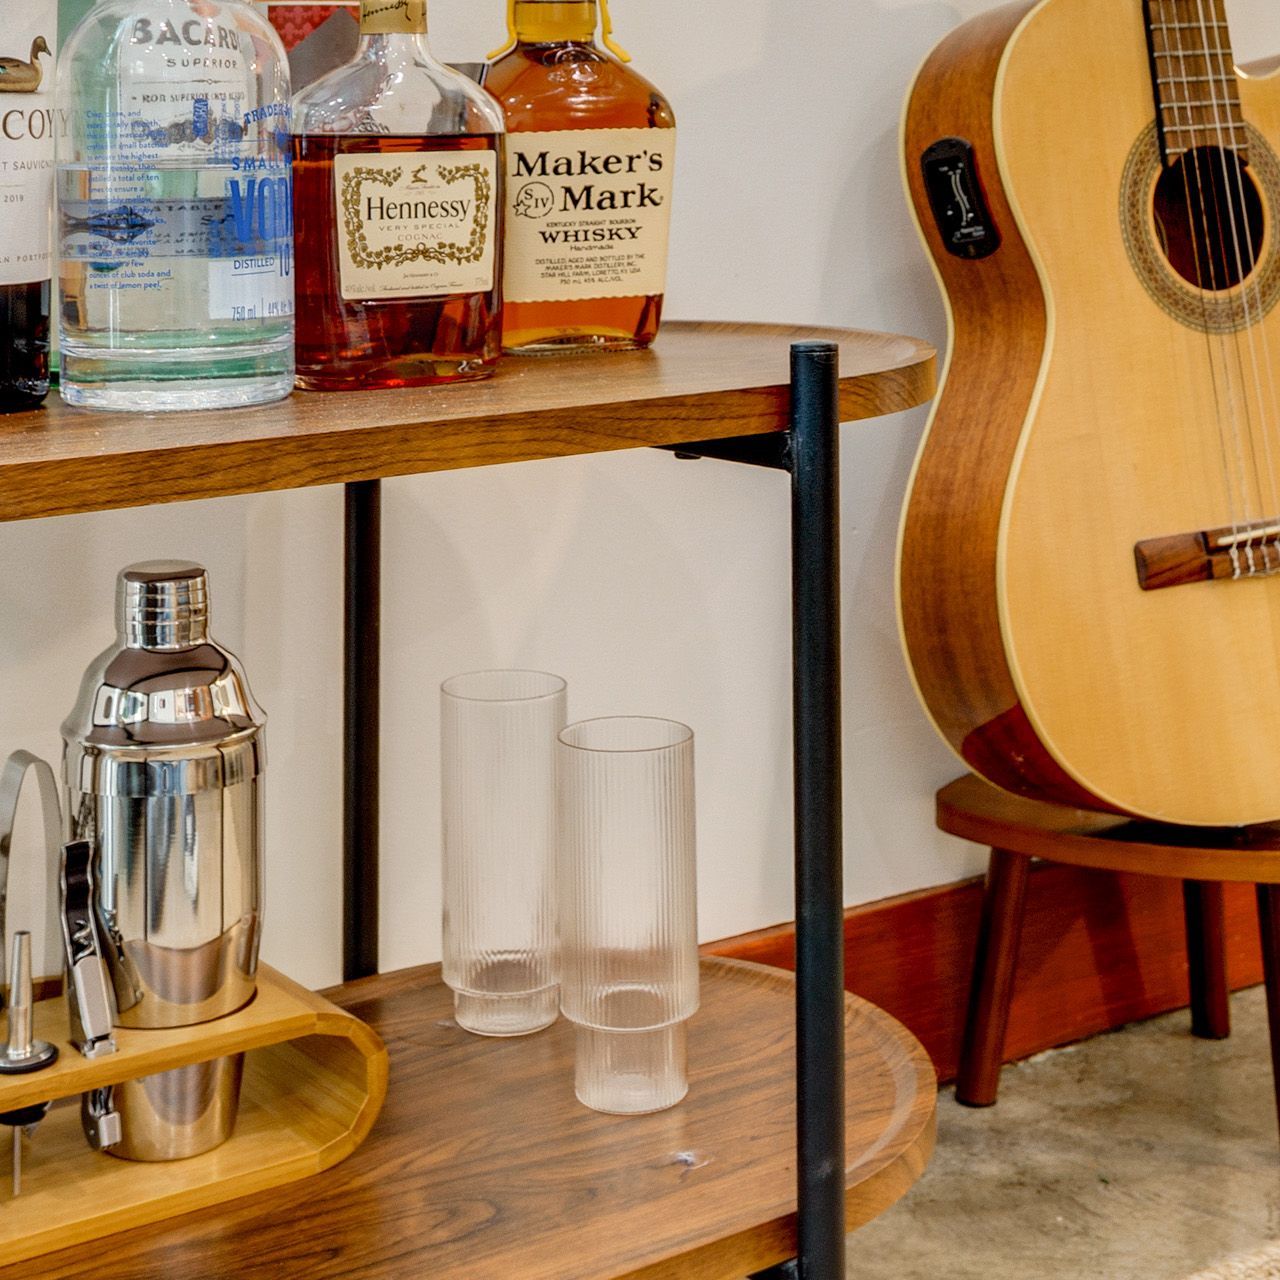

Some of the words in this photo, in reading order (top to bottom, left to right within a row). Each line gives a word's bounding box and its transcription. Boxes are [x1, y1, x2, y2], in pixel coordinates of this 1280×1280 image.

[167, 58, 237, 69] SUPERIOR
[511, 150, 663, 177] Maker's
[534, 197, 549, 209] IV
[559, 182, 662, 212] Mark
[366, 197, 471, 222] Hennessy
[397, 233, 443, 242] COGNAC
[538, 225, 643, 243] WHISKY
[233, 257, 275, 270] DISTILLED
